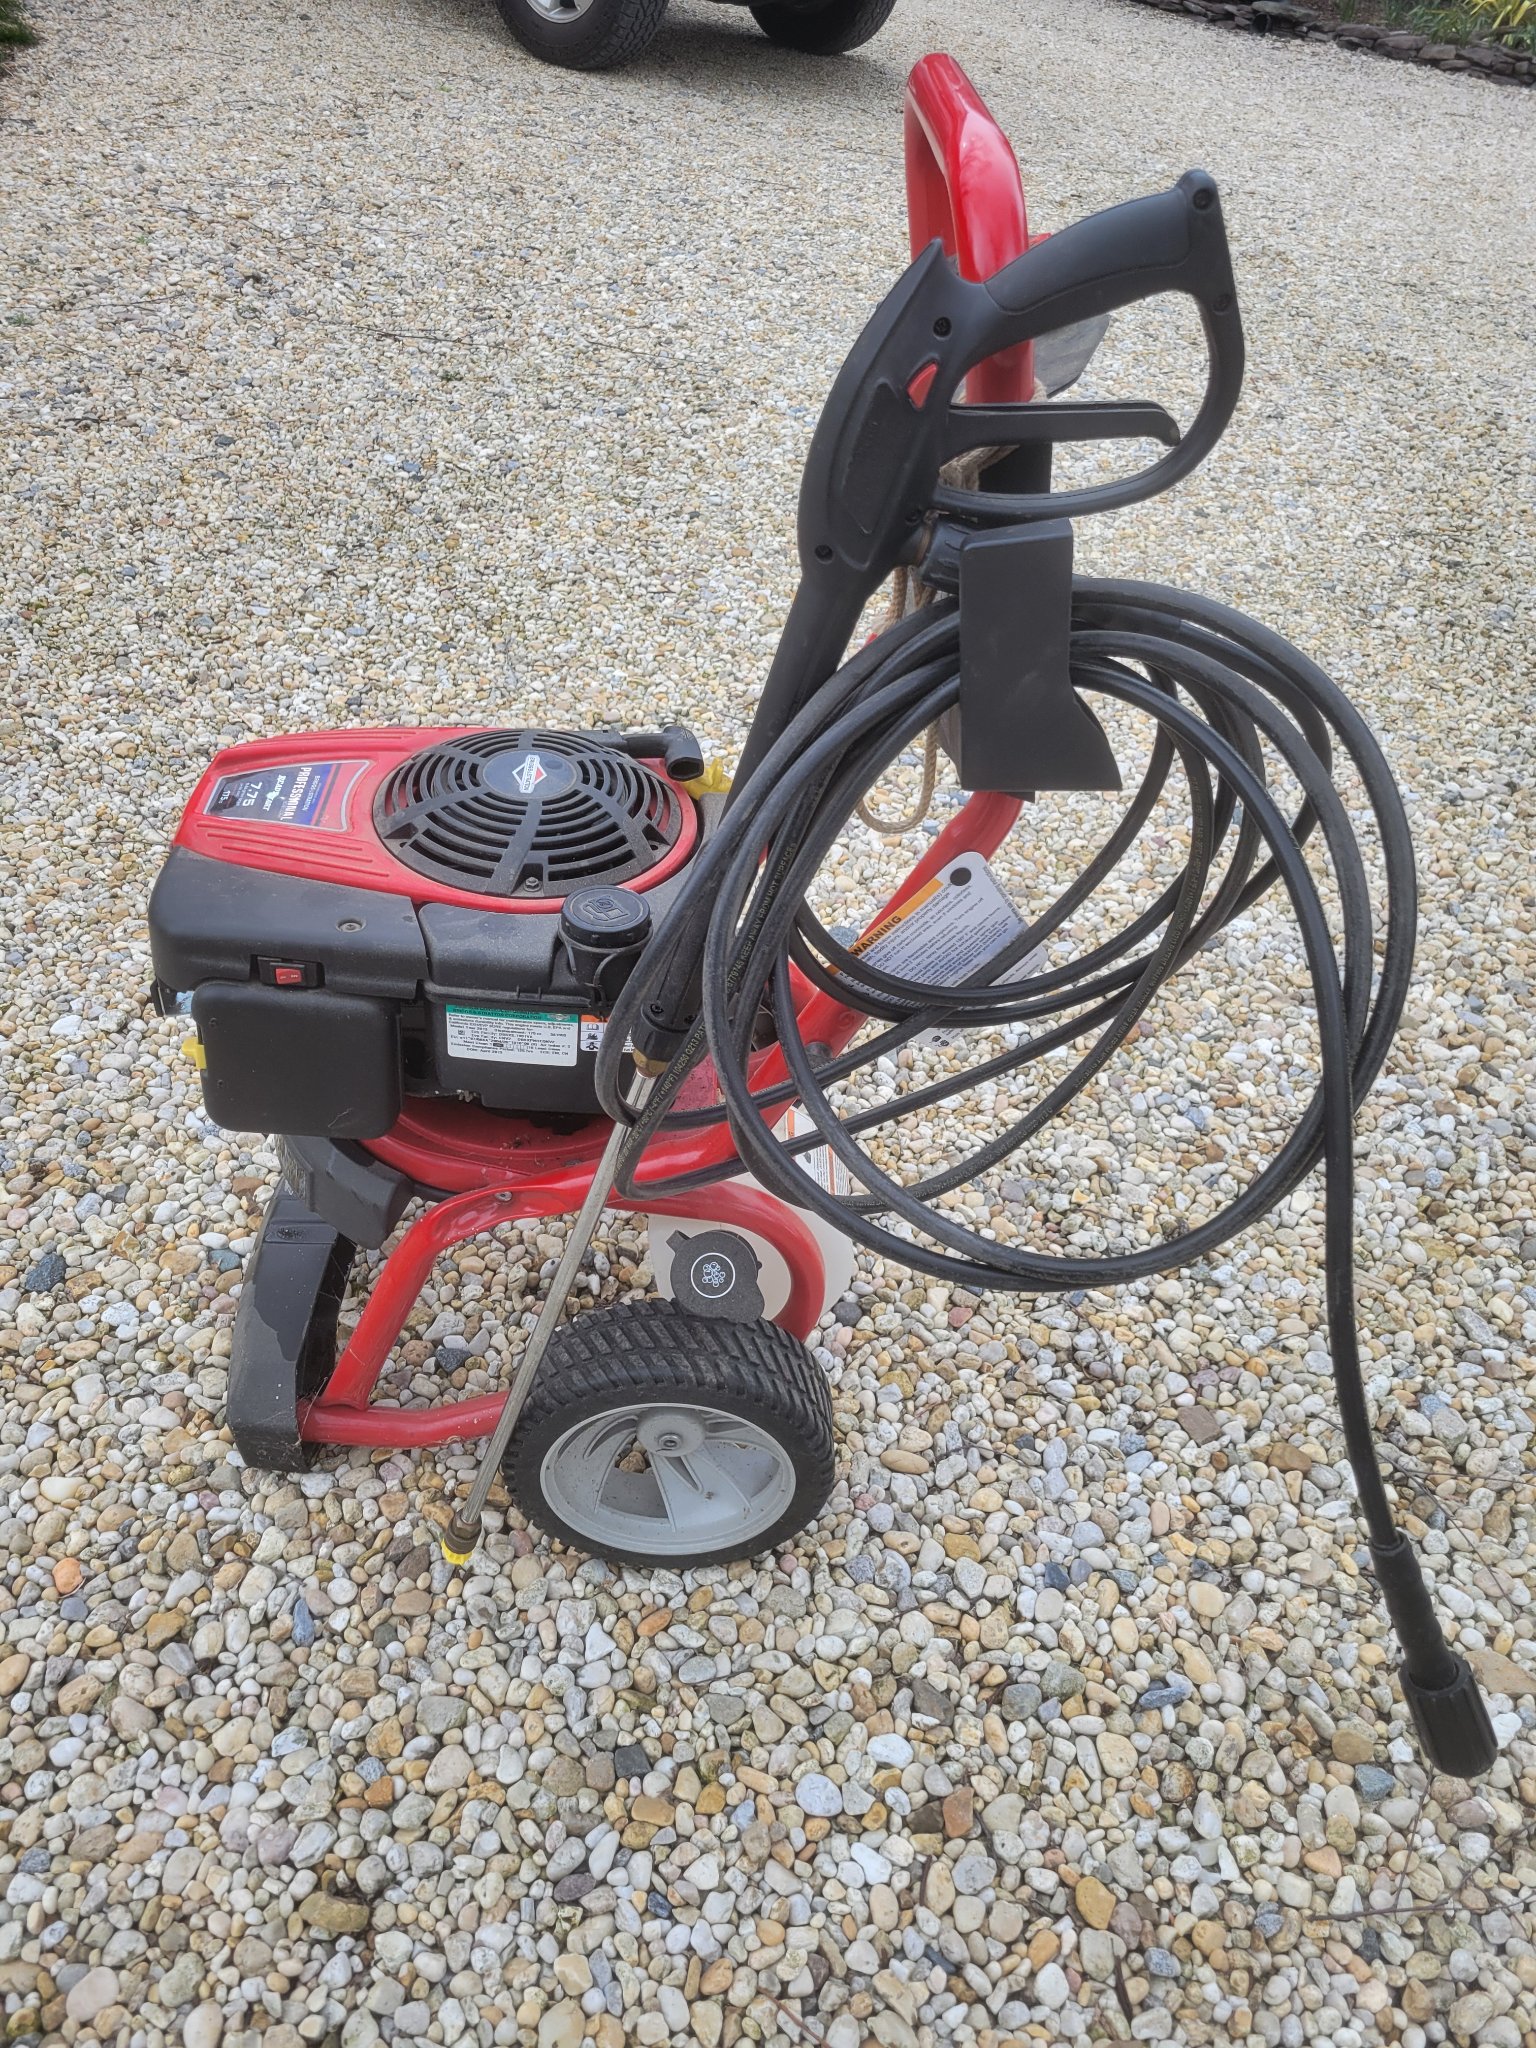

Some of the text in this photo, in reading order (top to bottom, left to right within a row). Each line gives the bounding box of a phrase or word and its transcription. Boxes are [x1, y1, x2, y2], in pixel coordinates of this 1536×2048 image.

[243, 782, 262, 806] 7.75
[281, 767, 312, 820] PROFESSIONAL
[741, 942, 753, 958] KEEP
[748, 920, 762, 943] AWAY
[759, 898, 771, 920] FROM
[767, 881, 778, 898] HOT
[913, 906, 933, 924] property
[850, 913, 902, 958] WARNING
[883, 953, 894, 963] NOT
[673, 1055, 689, 1075] 104250
